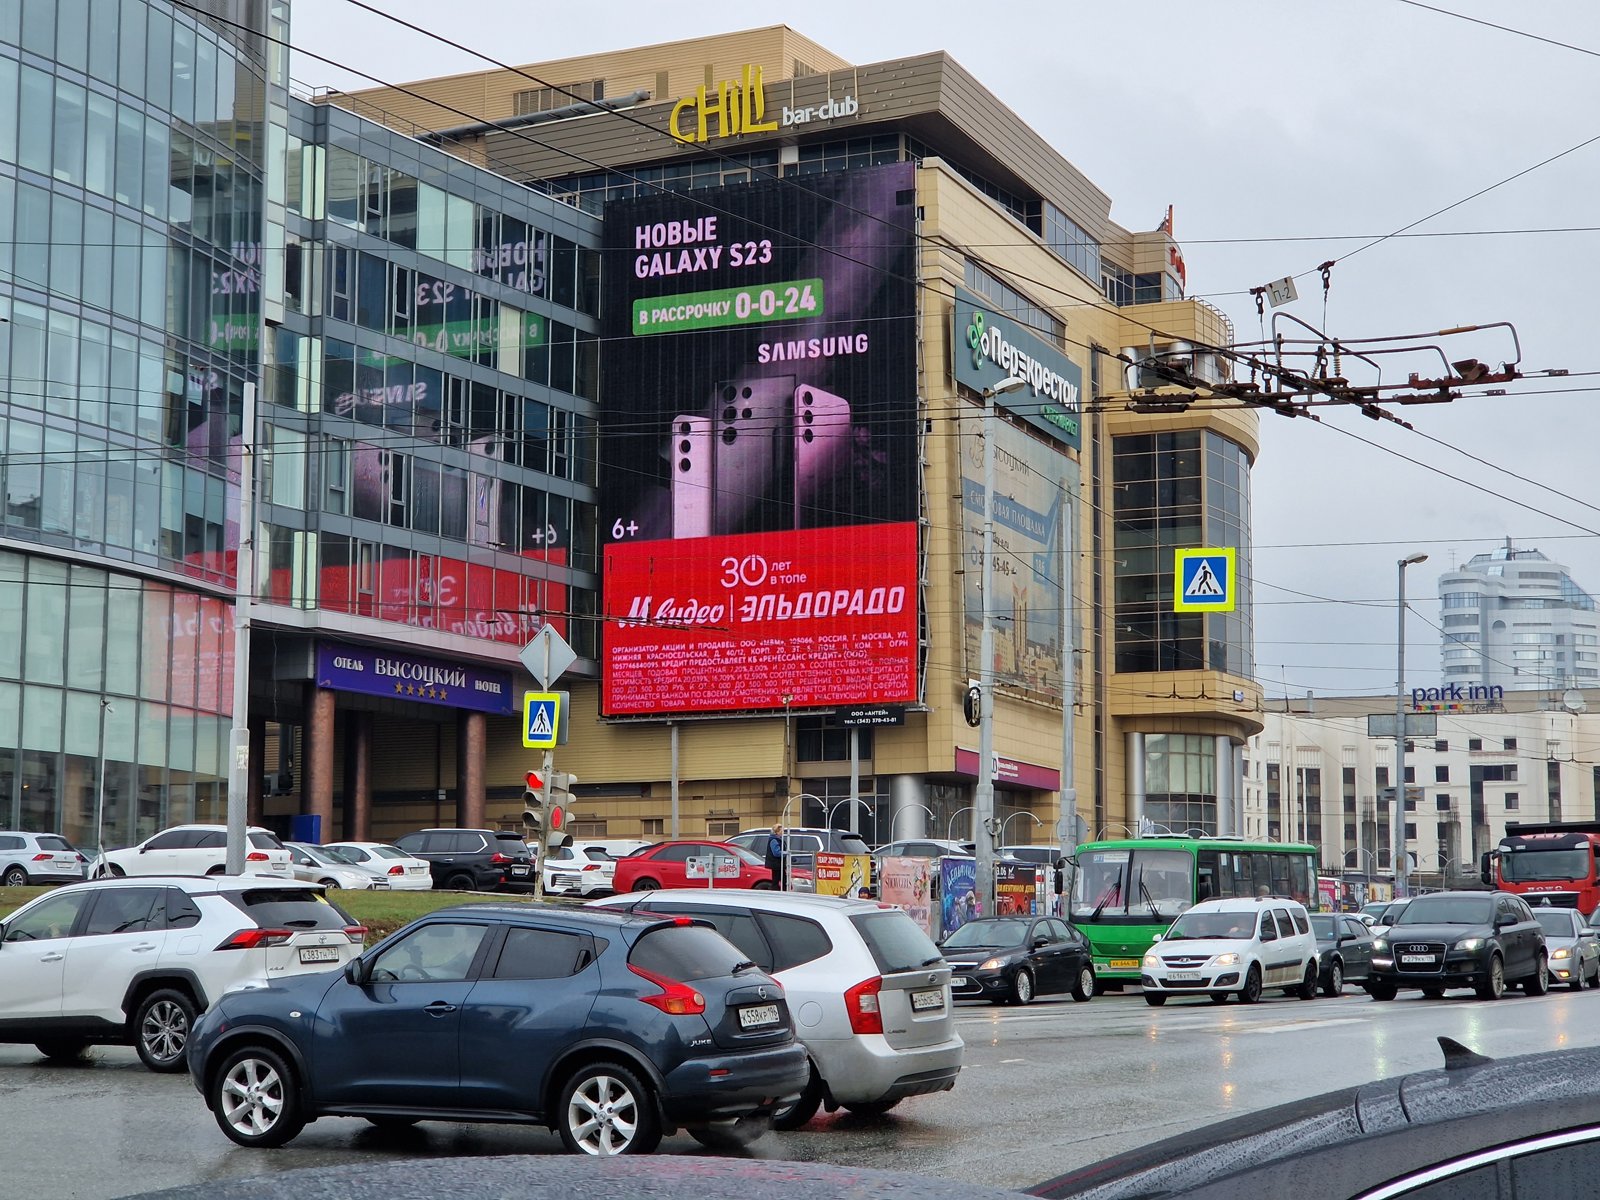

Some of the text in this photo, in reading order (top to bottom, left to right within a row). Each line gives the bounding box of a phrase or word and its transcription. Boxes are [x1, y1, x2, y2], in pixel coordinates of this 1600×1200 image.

[782, 96, 859, 127] bar-club
[635, 216, 717, 249] НОВЫЕ
[635, 239, 772, 278] GALAXY S23
[639, 285, 817, 325] В РАССРОЧКУ 0-0-24
[757, 333, 869, 364] SAMSUNG
[612, 518, 639, 539] 6+
[771, 560, 792, 572] лет
[779, 573, 807, 584] топе
[738, 586, 906, 622] ЭЛЬДОРАДО
[612, 645, 659, 654] ОРГАНИЗАТОР
[662, 643, 686, 651] АКЦИИ
[740, 639, 757, 648] ООО
[889, 639, 909, 648] ОГРН
[661, 659, 688, 667] КРЕДИТ
[689, 656, 747, 666] ПРЕДОСТАВЛЯЕТ
[681, 666, 726, 675] ПРОЦЕНТНАЯ
[375, 657, 466, 688] ВЫСОЦКИЙ
[612, 677, 652, 686] СТОИМОСТЬ
[835, 667, 860, 675] СУММА
[862, 666, 893, 674] КРЕДИТА
[612, 692, 660, 701] ПРИНИМАЕТСЯ
[661, 690, 690, 699] БАНКОМ
[691, 690, 702, 698] ПО
[702, 689, 730, 698] СВОЕМУ
[791, 685, 827, 694] ЯВЛЯЕТСЯ
[828, 681, 872, 691] ПУБЛИЧНОЙ
[627, 685, 638, 693] ДО
[735, 680, 746, 689] ДО
[800, 677, 833, 685] РЕШЕНИЕ
[878, 673, 909, 682] КРЕДИТА
[612, 700, 655, 709] КОЛИЧЕСТВО
[661, 699, 686, 707] ТОВАРА
[690, 697, 736, 706] ОГРАНИЧЕНО
[742, 695, 771, 704] СПИСОК
[814, 691, 867, 700] УЧАСТВУЮЩИХ
[884, 689, 909, 698] АКЦИИ
[1412, 683, 1504, 709] park inn
[741, 1007, 768, 1024] К558КР
[690, 1039, 712, 1047] JUKE
